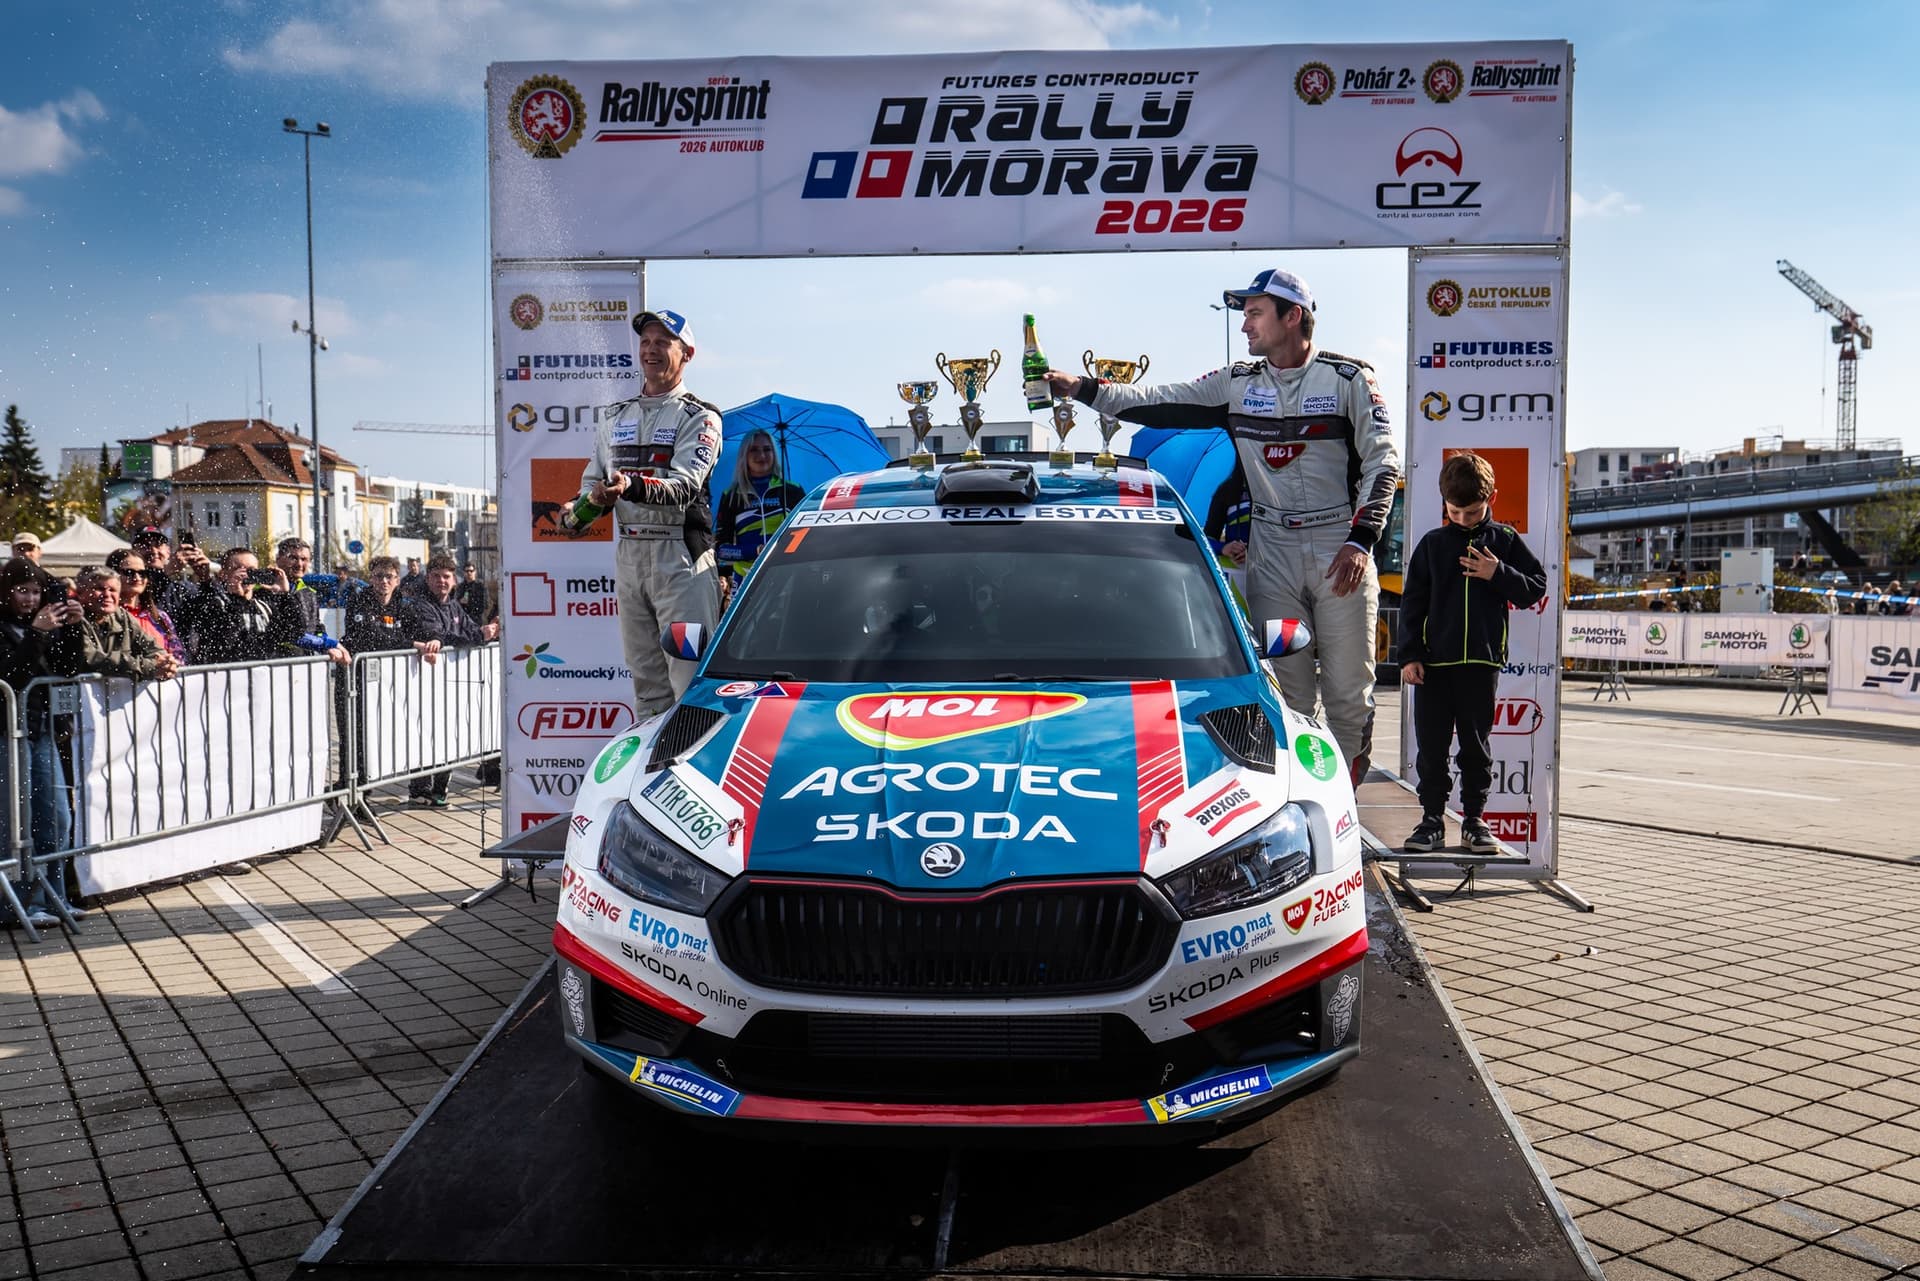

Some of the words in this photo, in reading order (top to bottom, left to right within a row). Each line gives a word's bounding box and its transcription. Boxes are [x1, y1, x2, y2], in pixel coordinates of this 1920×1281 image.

[707, 74, 730, 86] serie
[941, 74, 1037, 90] FUTURES
[1044, 71, 1199, 88] CONTPRODUCT
[1343, 66, 1395, 90] Pohár
[1397, 68, 1416, 89] 2+
[1471, 63, 1562, 89] Rallysprint
[599, 77, 770, 127] Rallysprint
[679, 140, 706, 153] 2026
[709, 139, 765, 152] AUTOKLUB
[1095, 198, 1247, 235] 2026
[1411, 211, 1455, 219] european
[1467, 287, 1551, 299] AUTOKLUB
[549, 300, 628, 313] AUTOKLUB
[1467, 300, 1497, 309] ČESKÉ
[1449, 341, 1554, 355] FUTURES
[533, 354, 633, 369] FUTURES
[1449, 358, 1523, 370] contproduct
[1525, 358, 1555, 368] s.r.o.
[533, 370, 604, 383] contproduct
[607, 371, 635, 380] s.r.o.
[1243, 399, 1264, 407] EVRO
[1457, 393, 1554, 422] grm
[1267, 447, 1294, 458] MOL
[799, 508, 930, 526] FRANCO
[941, 506, 1026, 519] REAL
[1036, 507, 1176, 522] ESTATES
[784, 527, 810, 553] 1
[1584, 636, 1627, 646] MOTOR
[1704, 629, 1768, 641] SAMOHÝL
[1719, 640, 1768, 650] MOTOR
[539, 666, 616, 681] Olomoucký
[1527, 663, 1550, 677] kraj
[870, 696, 1001, 719] MOL
[525, 758, 586, 769] NUTREND
[780, 761, 1118, 801] AGROTEC
[1196, 786, 1251, 826] arexons
[573, 876, 622, 923] RACING
[1313, 870, 1363, 912] RACING
[628, 908, 679, 949] EVRO
[681, 932, 709, 953] mat
[1180, 925, 1247, 965] EVRO
[1246, 911, 1273, 933] mat
[1250, 951, 1280, 975] Plus
[697, 981, 748, 1011] Online
[657, 1073, 724, 1105] MICHELIN
[1190, 1075, 1260, 1105] MICHELIN
